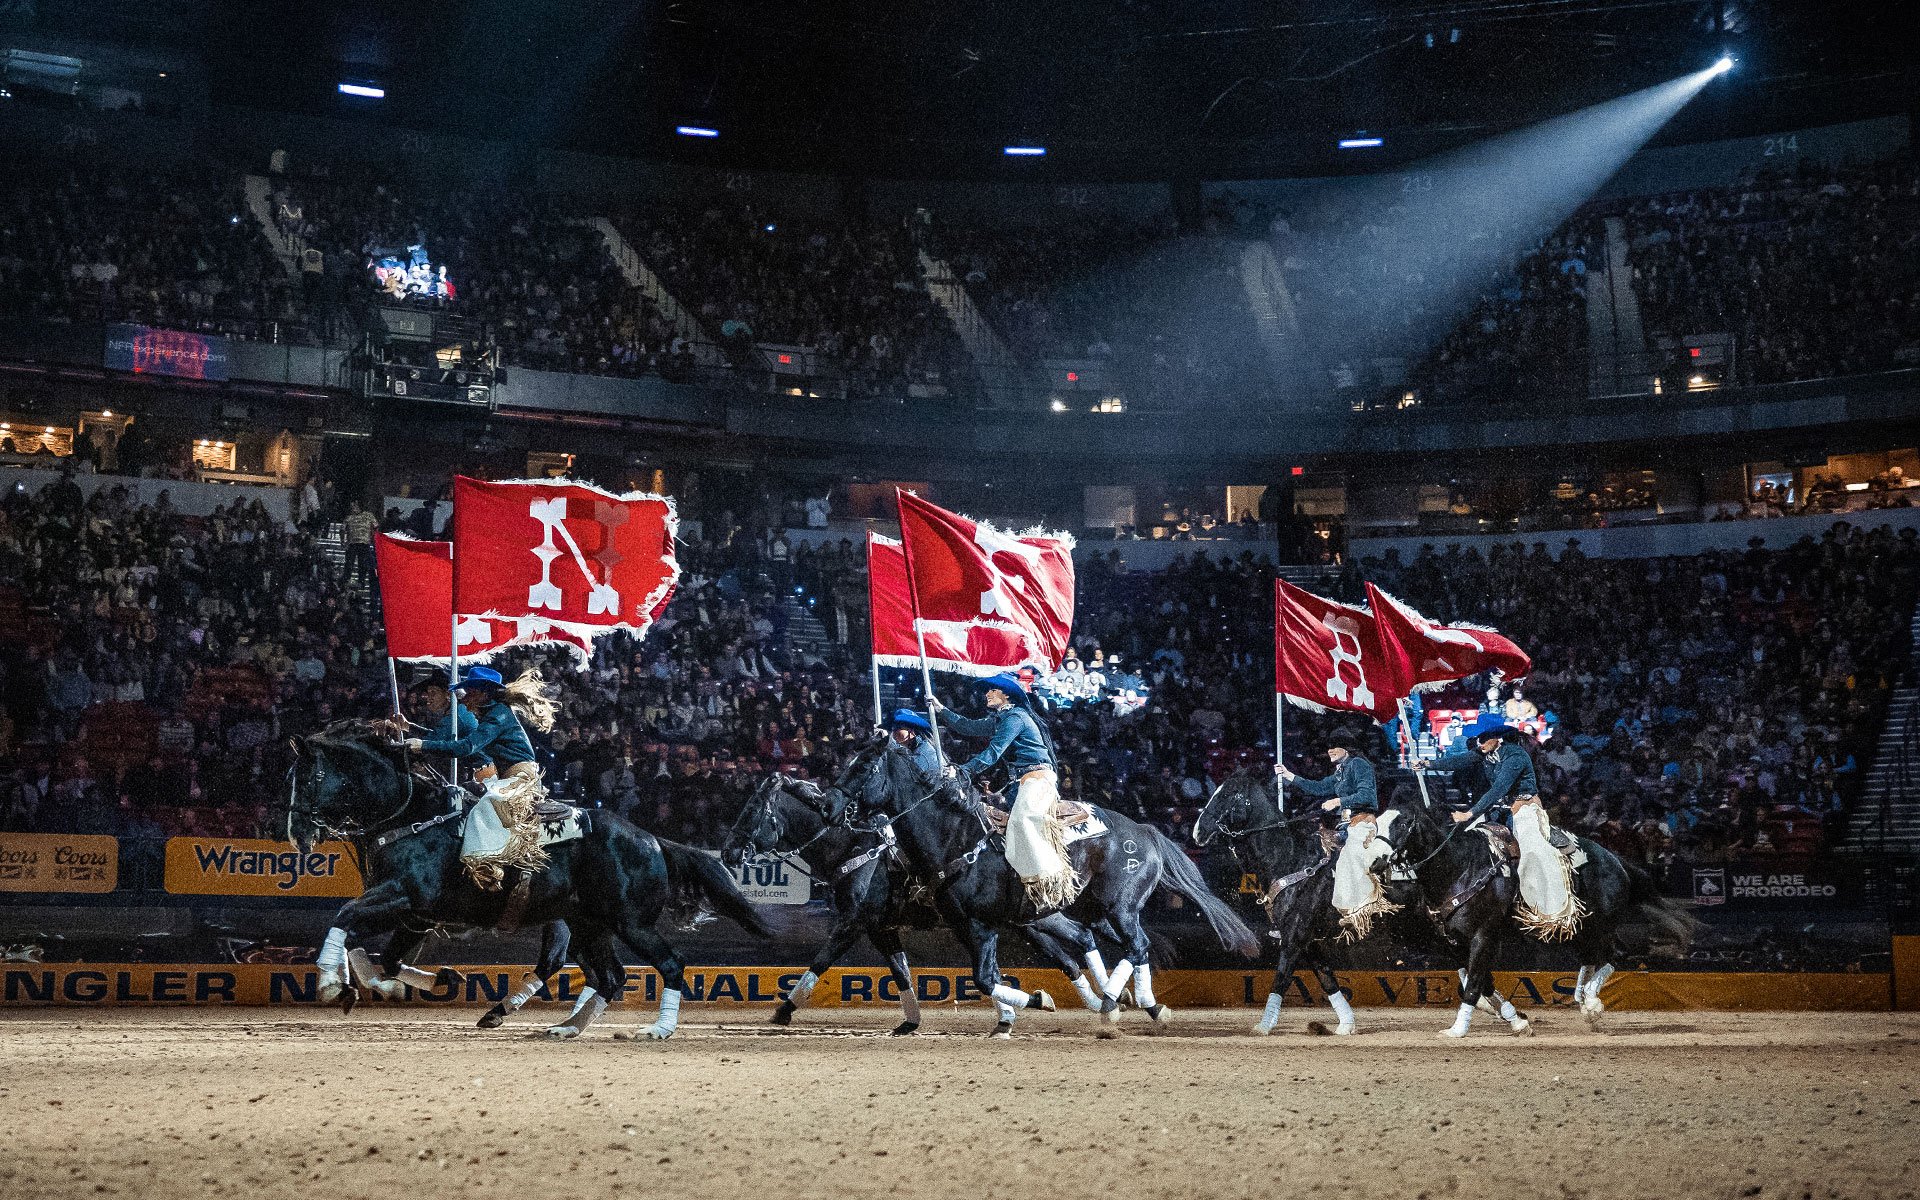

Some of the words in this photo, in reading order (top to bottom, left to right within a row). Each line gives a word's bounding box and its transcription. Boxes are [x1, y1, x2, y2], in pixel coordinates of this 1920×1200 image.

[1763, 135, 1798, 156] 214
[1402, 175, 1432, 192] 213
[0, 847, 38, 865] oors
[54, 845, 108, 865] Coors
[194, 845, 341, 890] Wrangler
[1732, 875, 1762, 886] WE
[1766, 874, 1804, 886] ARE
[1732, 885, 1836, 898] PRORODEO
[3, 971, 235, 1002] NGLER
[267, 972, 581, 1002] NIONAL
[1374, 976, 1580, 1005] VEAS
